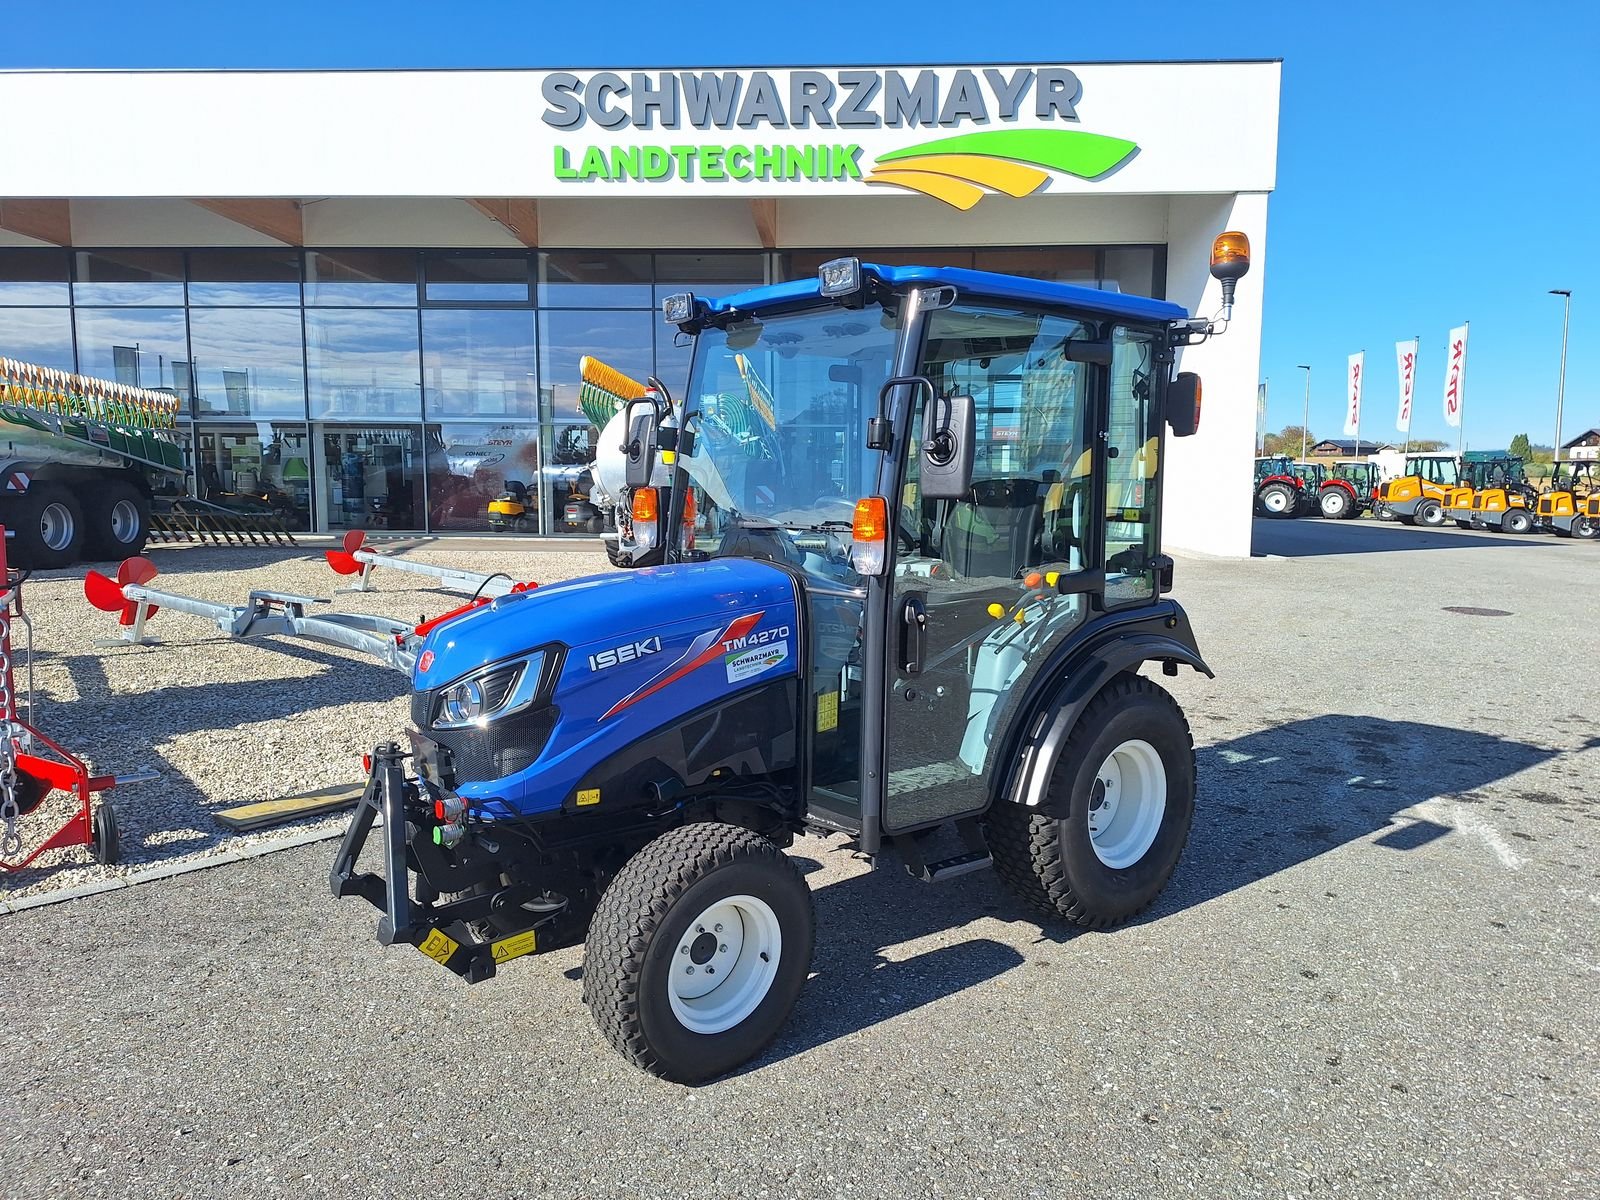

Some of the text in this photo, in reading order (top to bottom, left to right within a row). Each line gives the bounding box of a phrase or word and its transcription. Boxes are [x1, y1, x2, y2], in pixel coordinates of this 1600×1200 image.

[541, 68, 1081, 129] SCHWARZMAYR
[553, 144, 864, 181] LANDTECHNIK
[588, 636, 662, 672] ISEKI
[732, 648, 780, 668] SCHWARZMAYR
